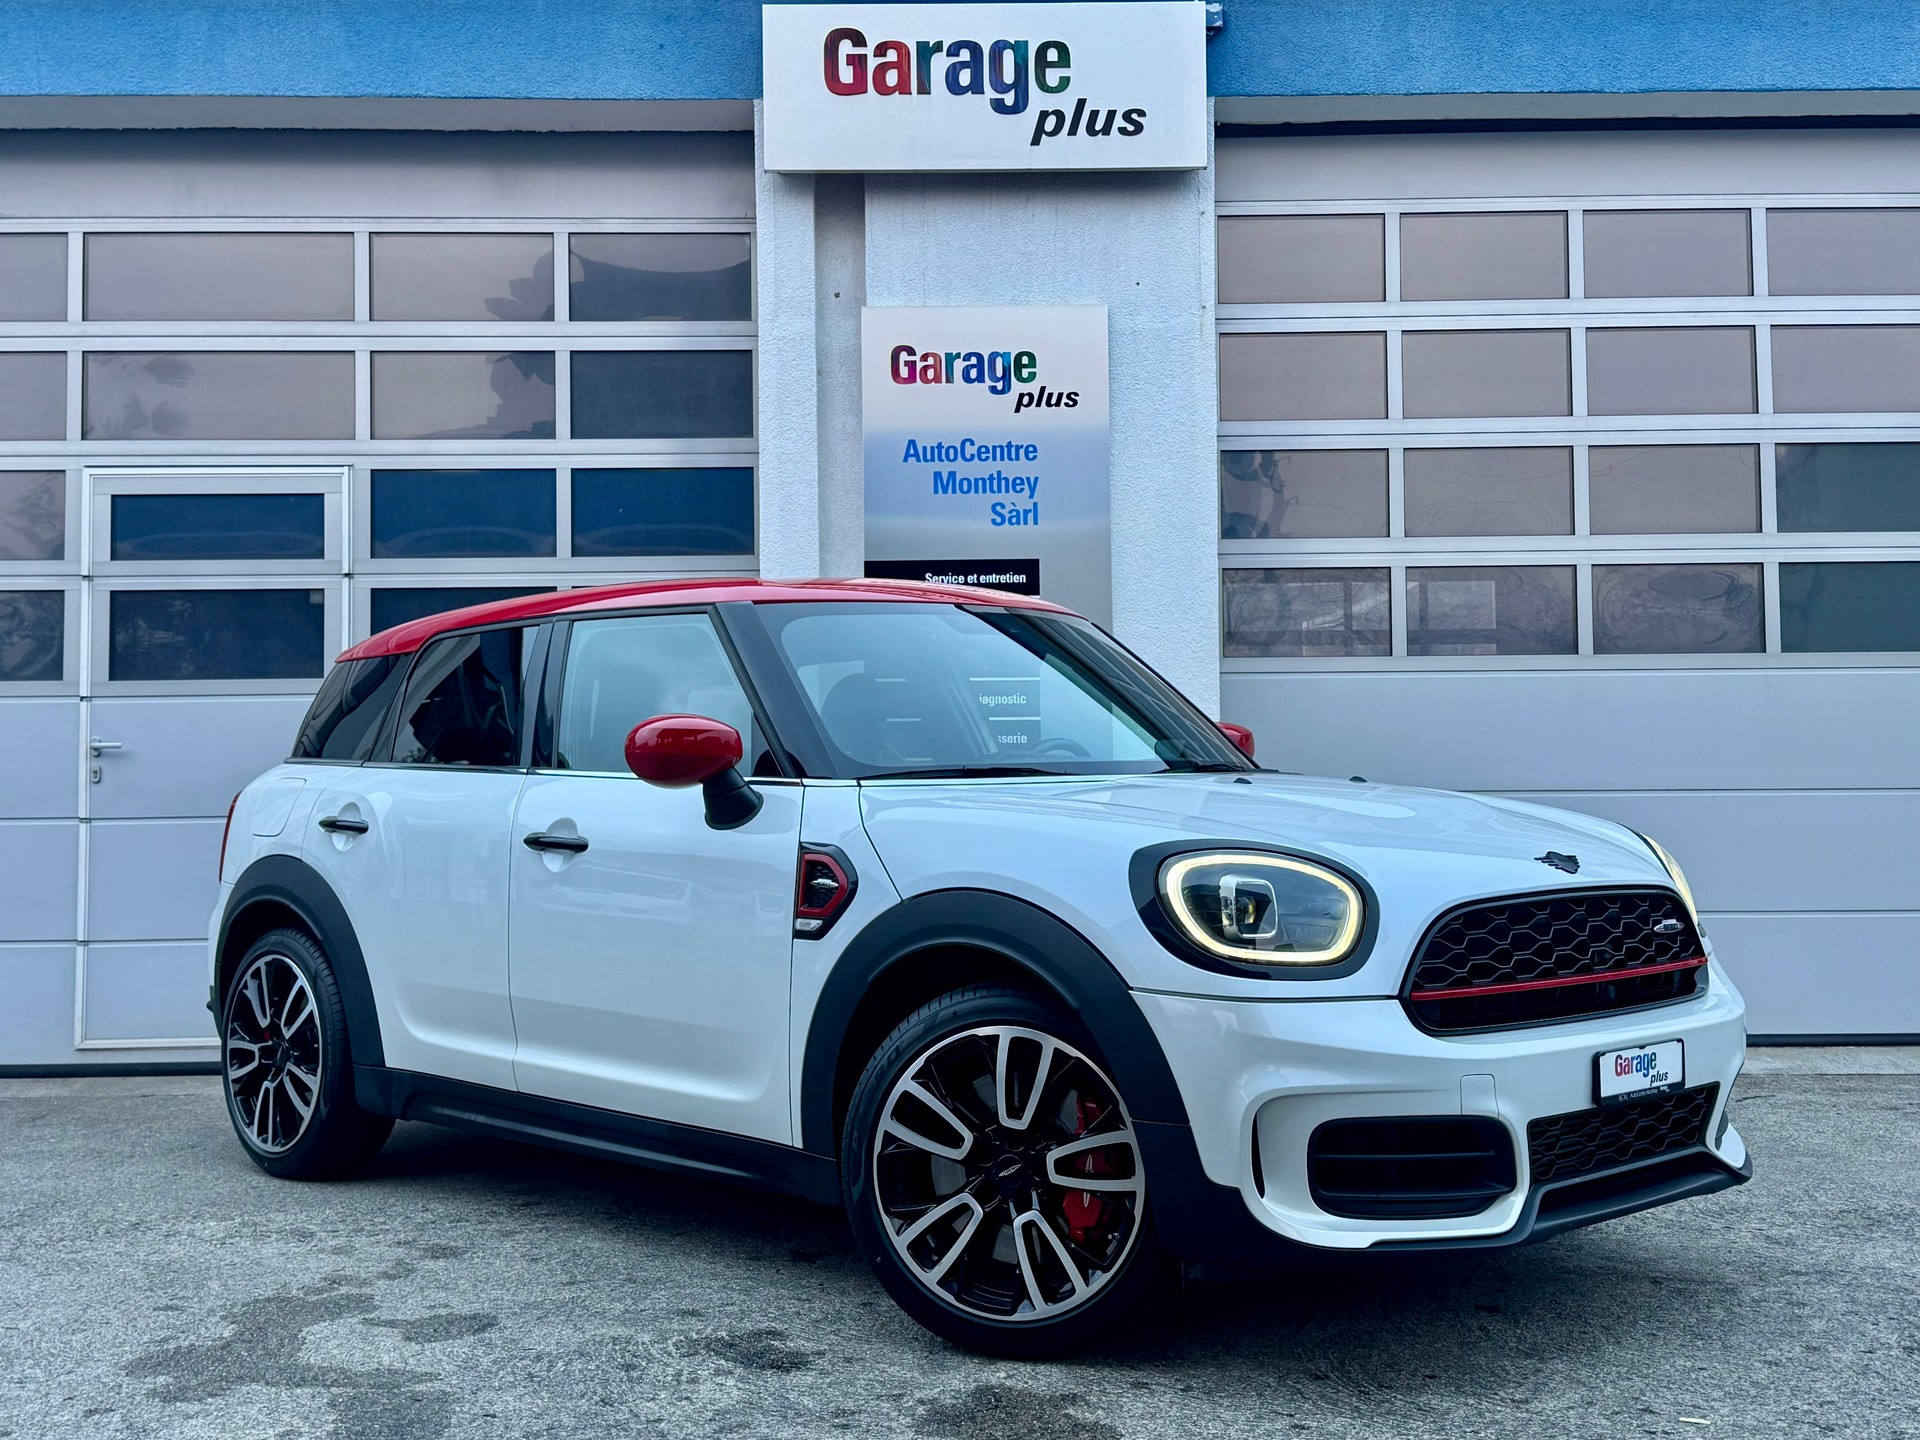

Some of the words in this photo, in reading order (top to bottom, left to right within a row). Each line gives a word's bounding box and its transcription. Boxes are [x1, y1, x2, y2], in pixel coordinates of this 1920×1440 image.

[823, 27, 1072, 115] Garage
[1030, 97, 1147, 147] plus
[890, 344, 1038, 396] Garage
[1014, 385, 1080, 414] plus
[902, 438, 1039, 463] AutoCentre
[933, 470, 1039, 499] Monthey
[990, 501, 1039, 526] Sàrl
[925, 572, 965, 584] Service
[967, 573, 978, 584] et
[979, 571, 1027, 584] entretien
[978, 692, 1027, 707] iagnostic
[1614, 1051, 1657, 1078] Garage
[1650, 1069, 1669, 1087] plus
